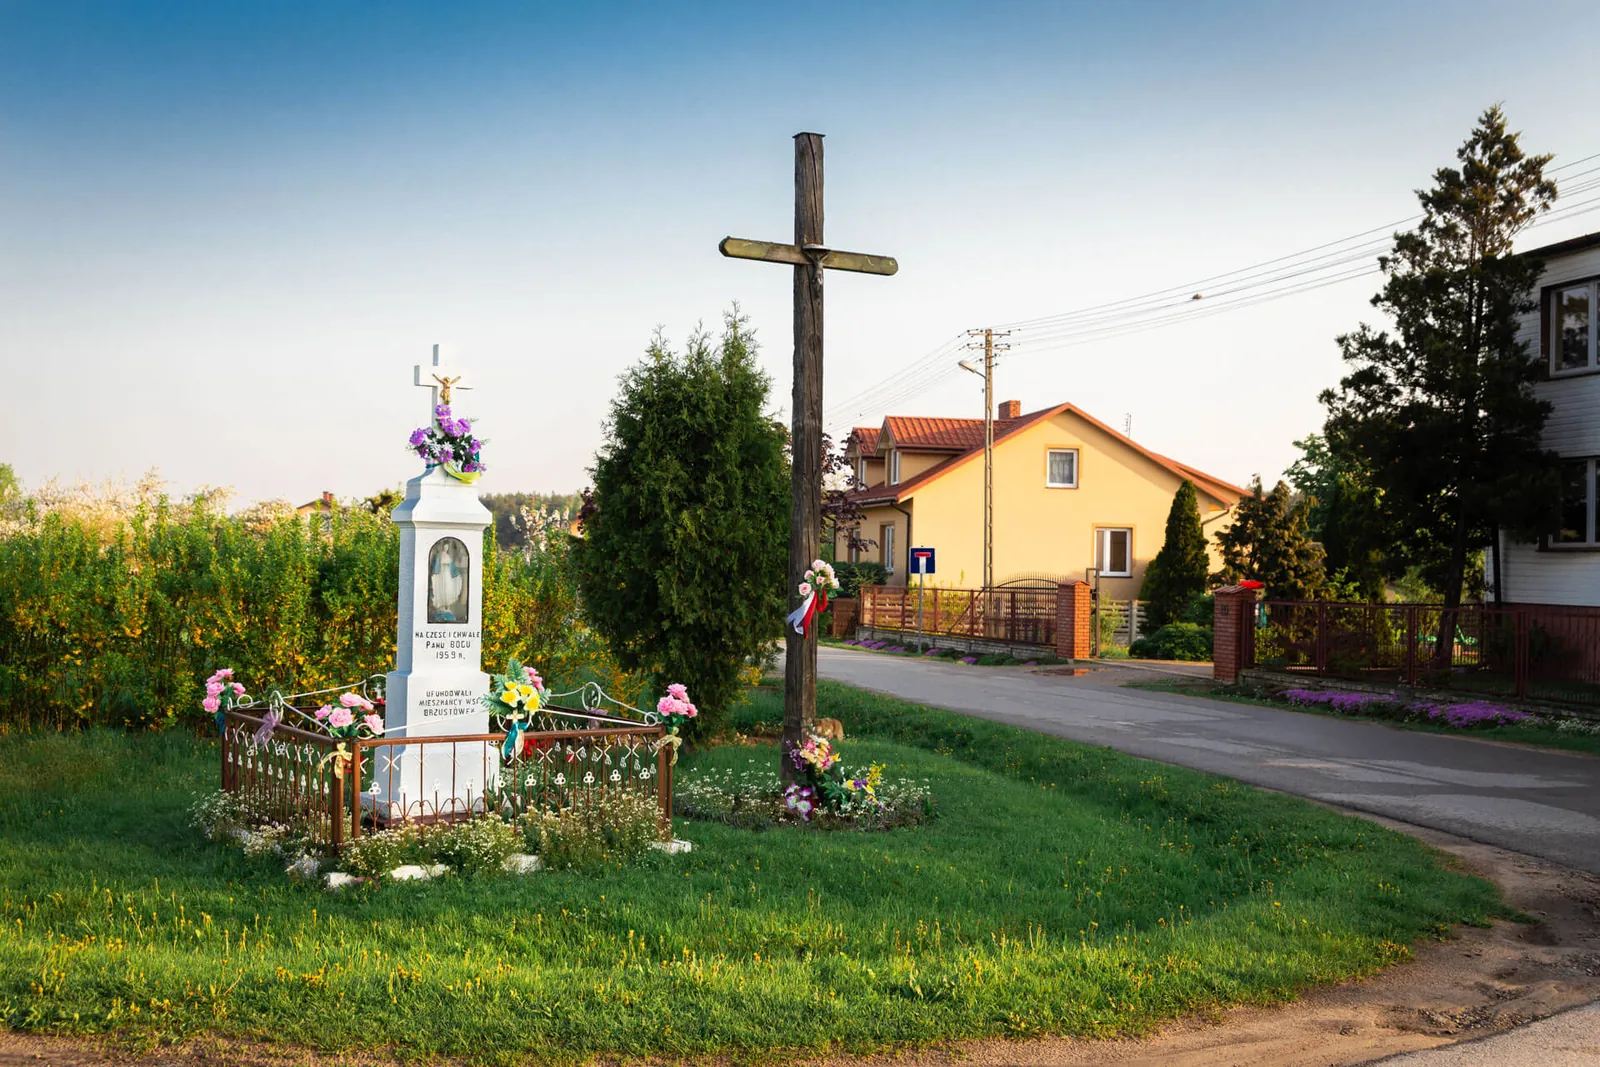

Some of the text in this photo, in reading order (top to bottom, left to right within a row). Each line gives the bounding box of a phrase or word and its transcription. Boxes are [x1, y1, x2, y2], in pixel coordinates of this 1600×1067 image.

[415, 631, 424, 639] NA
[450, 640, 471, 649] BOGU
[435, 651, 456, 660] 1959
